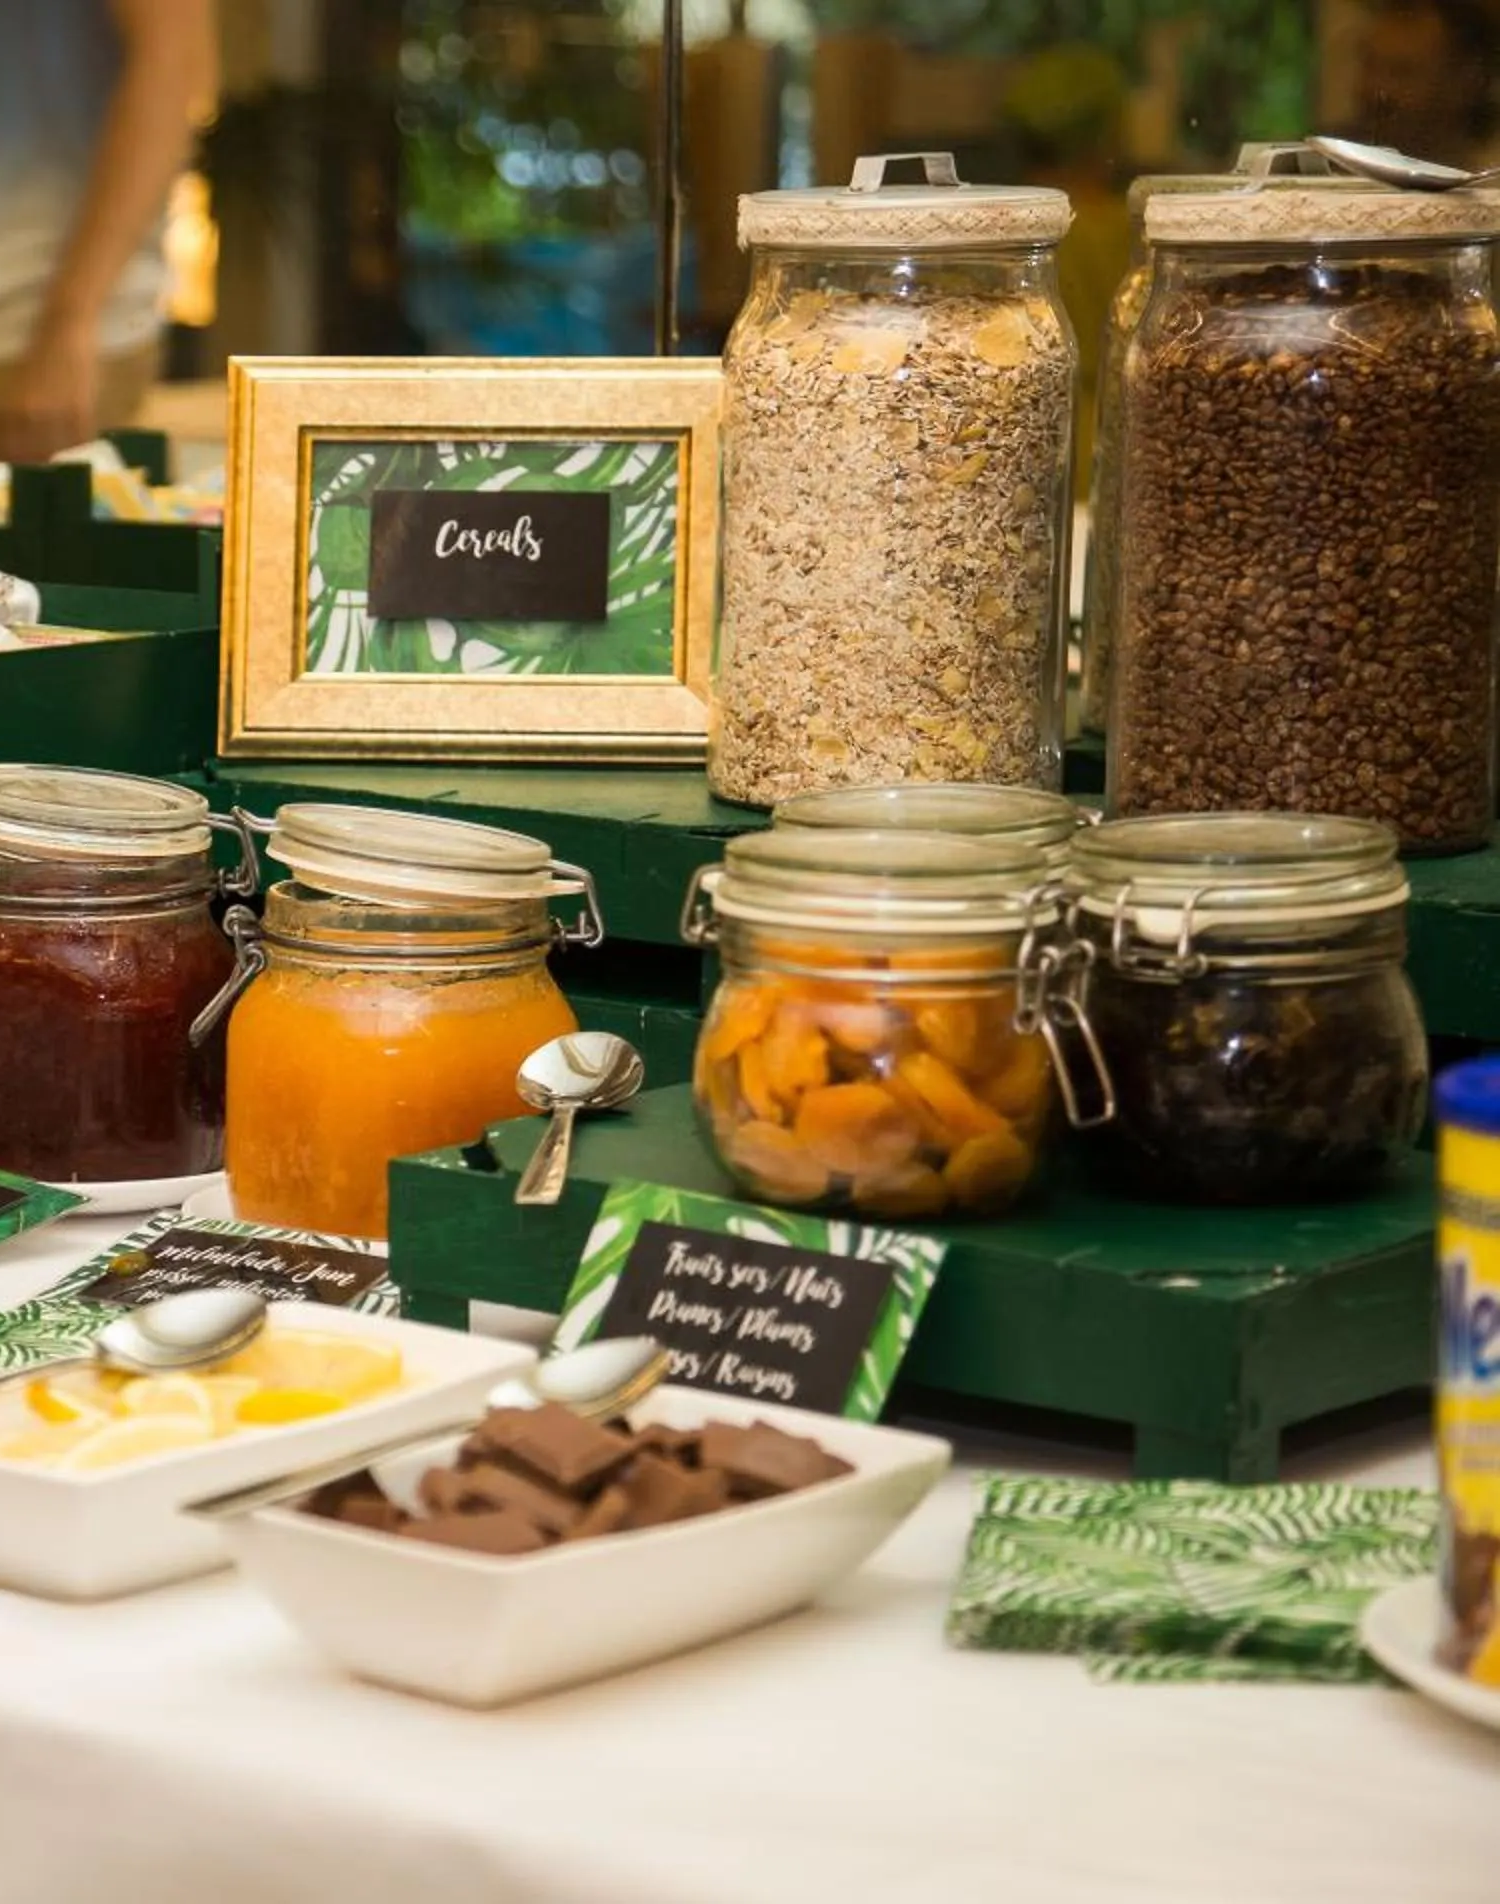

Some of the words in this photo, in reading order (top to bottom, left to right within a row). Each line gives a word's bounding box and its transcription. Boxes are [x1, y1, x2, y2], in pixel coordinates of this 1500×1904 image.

[435, 515, 543, 561] Cereals
[291, 1262, 357, 1287] Jam
[783, 1266, 846, 1309] Nuts
